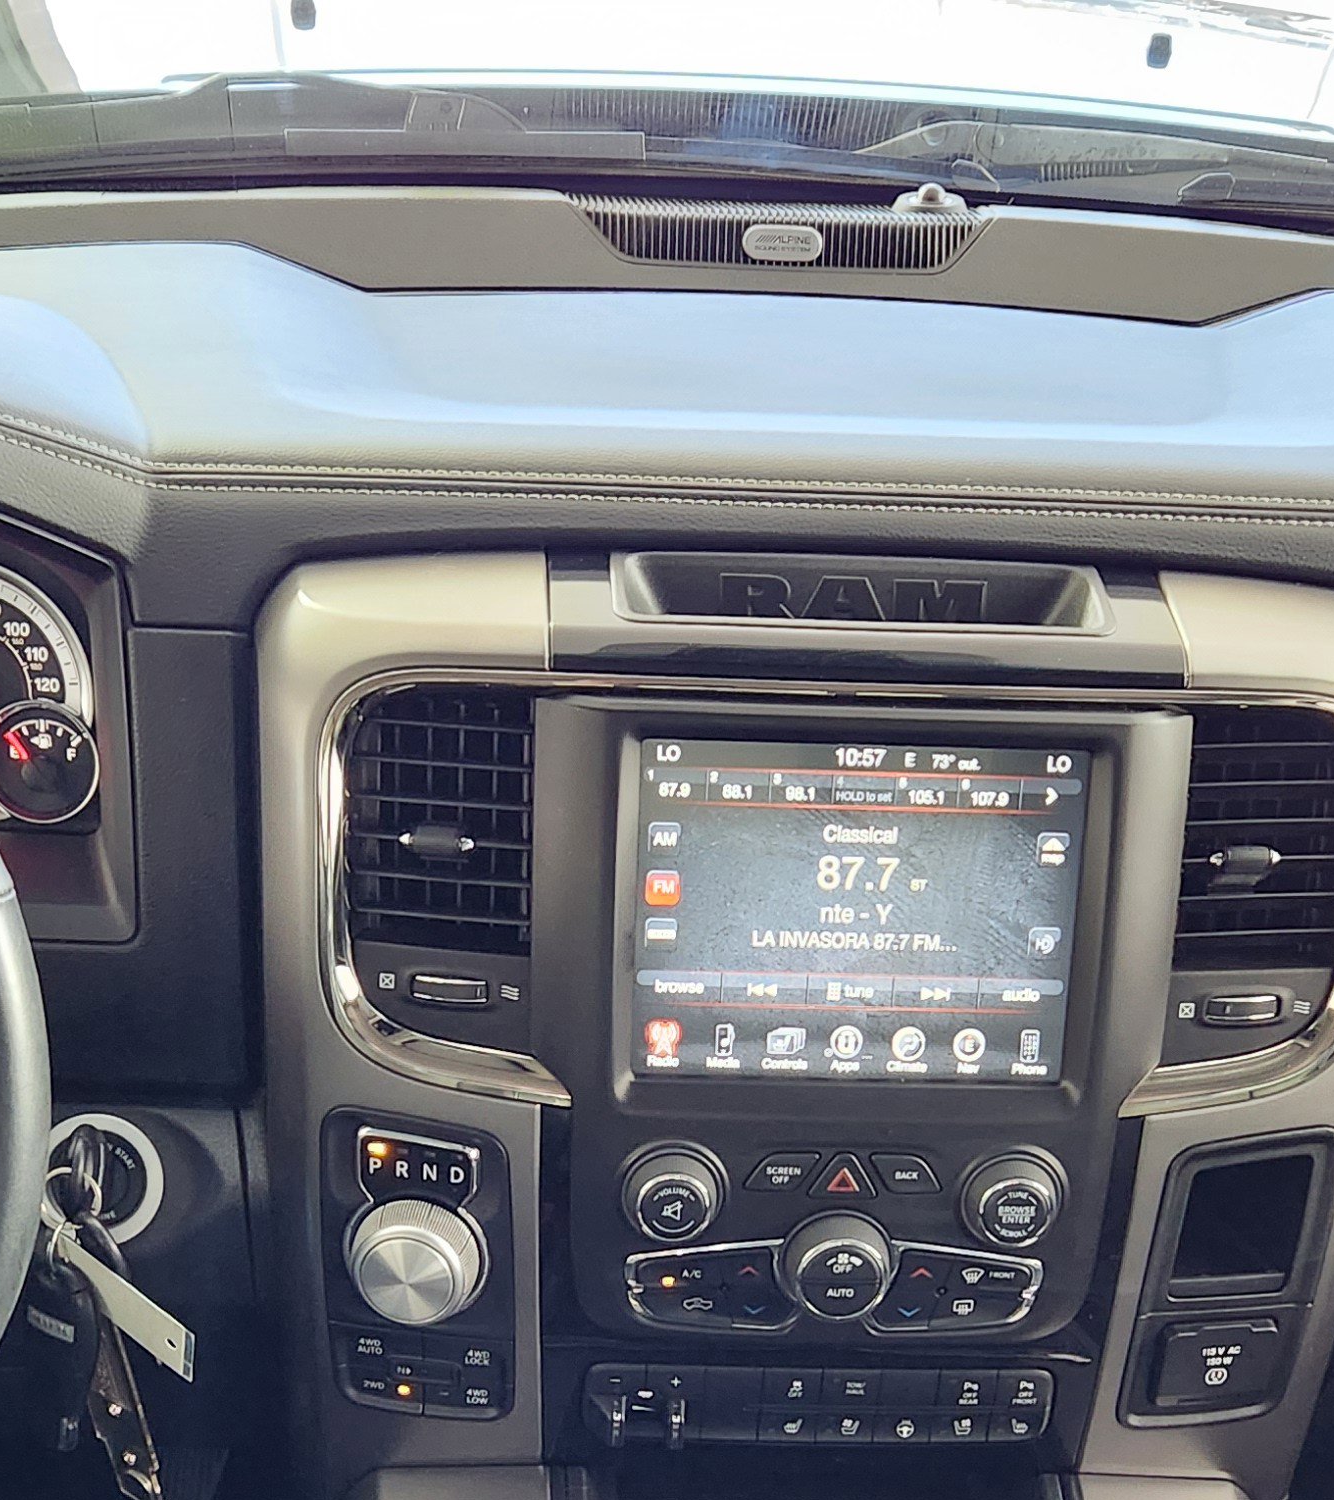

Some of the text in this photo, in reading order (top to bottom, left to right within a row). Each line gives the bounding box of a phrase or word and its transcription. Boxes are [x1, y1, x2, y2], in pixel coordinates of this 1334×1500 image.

[720, 572, 988, 621] RAM
[3, 622, 30, 637] 100
[24, 646, 49, 662] 110
[34, 677, 60, 692] 120
[66, 747, 77, 762] F
[656, 745, 682, 762] LO
[835, 747, 887, 768] 10:57
[904, 752, 916, 768] E
[1047, 755, 1072, 773] LO
[710, 771, 719, 783] 2
[658, 782, 692, 798] 87.9
[835, 791, 865, 802] HOLD
[866, 791, 876, 803] to
[652, 831, 678, 847] AM
[823, 823, 899, 845] Classical
[817, 855, 900, 892] 87.7
[652, 879, 676, 895] FM
[819, 904, 855, 924] nte
[875, 904, 894, 925] Y
[751, 930, 776, 948] LA
[778, 931, 869, 949] INVASORA
[654, 979, 704, 995] browse
[844, 985, 874, 1000] tune
[1002, 988, 1040, 1002] audio
[646, 1055, 679, 1068] Radio
[706, 1056, 740, 1069] Media
[761, 1057, 808, 1071] Controls
[830, 1059, 860, 1073] Apps
[886, 1061, 928, 1074] Climate
[957, 1063, 980, 1075] Nav
[1011, 1063, 1048, 1076] Phone
[114, 1146, 136, 1170] START
[368, 1158, 465, 1184] P R N D
[766, 1167, 801, 1176] SCREEN
[895, 1171, 918, 1180] BACK
[771, 1176, 790, 1184] OFF
[658, 1187, 690, 1198] VOLUME
[1007, 1191, 1029, 1200] TUNE
[998, 1206, 1036, 1216] BROWSE
[1002, 1215, 1030, 1224] ENTER
[682, 1268, 701, 1278] A/C
[833, 1264, 852, 1274] OFF
[989, 1271, 1015, 1279] FRONT
[826, 1287, 854, 1298] AUTO
[359, 1337, 381, 1347] 4WD
[357, 1345, 383, 1355] AUTO
[467, 1350, 490, 1359] 4WD
[465, 1356, 490, 1366] LOCK
[363, 1380, 385, 1390] 2WD
[466, 1388, 488, 1397] 4WD
[466, 1396, 488, 1405] LOW
